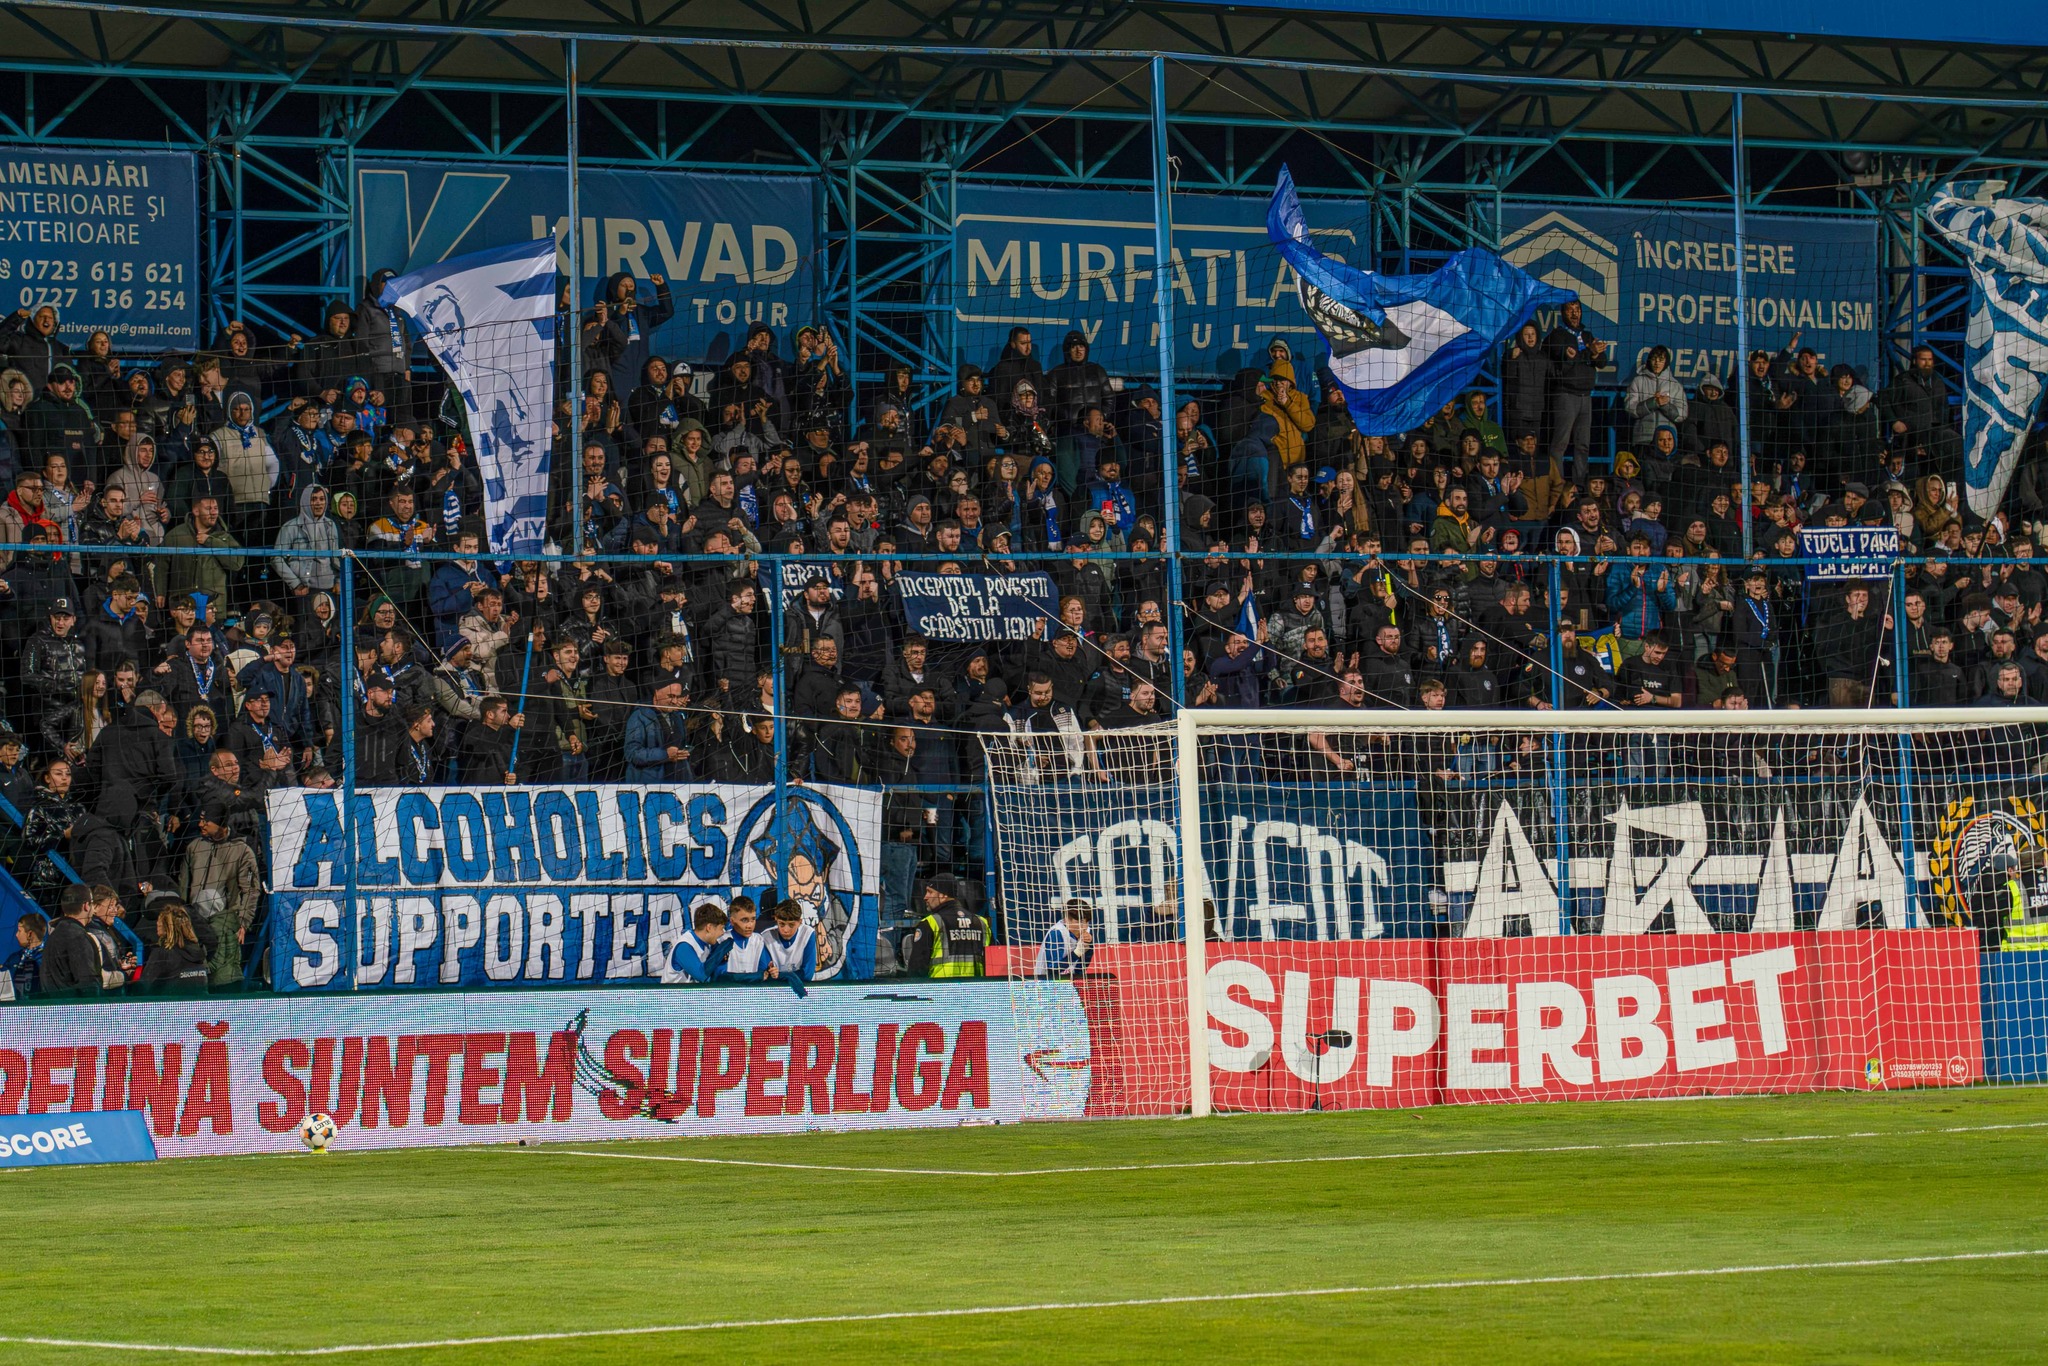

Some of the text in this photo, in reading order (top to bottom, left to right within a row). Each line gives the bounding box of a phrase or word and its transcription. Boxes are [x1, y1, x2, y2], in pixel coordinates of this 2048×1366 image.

[1634, 231, 1796, 275] ÎNCREDERE
[20, 259, 183, 284] 0723 615 621
[968, 239, 1346, 308] MURFATLA
[19, 286, 186, 311] 0727 136 254
[692, 298, 788, 328] TOUR
[1638, 292, 1873, 331] PROFESIONALISM
[1803, 533, 1856, 554] FIDELI
[896, 573, 981, 598] ÎNCEPUTUL
[947, 595, 1002, 617] DE LA
[1003, 616, 1049, 642] IERNI
[292, 790, 729, 887] ALCOHOLICS
[957, 917, 972, 929] ZIP
[292, 893, 729, 988] SUPPORTER
[1205, 945, 1797, 1090] SUPERBET
[258, 1031, 577, 1134] SUNTEM
[600, 1020, 990, 1121] SUPERLIGA
